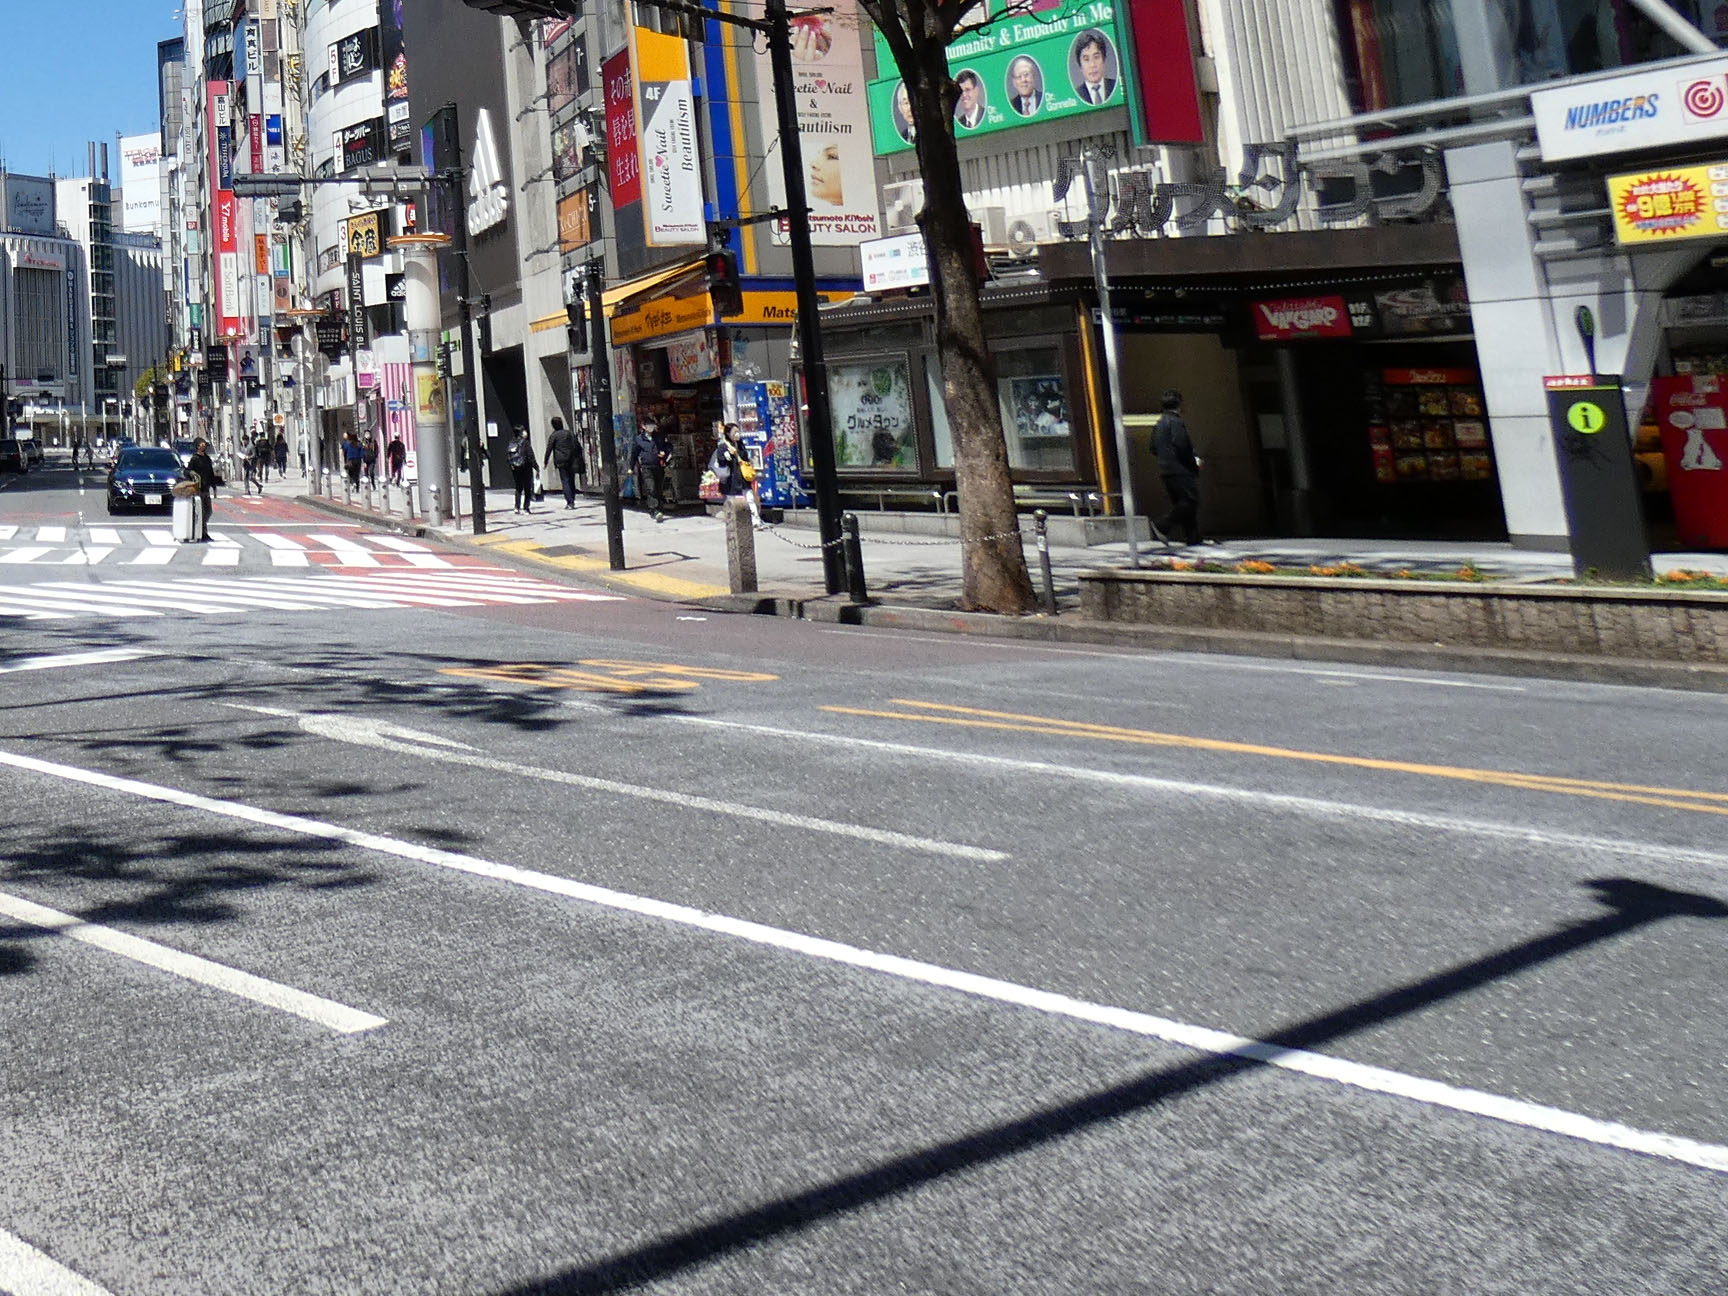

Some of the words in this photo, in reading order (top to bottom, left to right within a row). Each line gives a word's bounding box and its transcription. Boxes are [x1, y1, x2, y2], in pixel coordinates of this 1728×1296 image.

[999, 29, 1011, 47] &
[1013, 15, 1068, 43] Empathy
[1072, 12, 1088, 26] in
[645, 87, 661, 101] 4F
[822, 82, 853, 95] Nail
[809, 98, 818, 109] &
[1565, 93, 1660, 130] NUMBERS
[343, 125, 372, 144] ダーツバー
[655, 128, 669, 160] Nail
[678, 98, 694, 172] Beautilism
[345, 147, 373, 167] BAGUS
[661, 166, 673, 213] Sweetie
[835, 223, 877, 233] SALON
[223, 271, 236, 314] SoftBank
[351, 272, 362, 302] SAINT
[354, 304, 363, 333] LOUIS
[762, 306, 797, 320] Mats
[356, 336, 365, 350] BL
